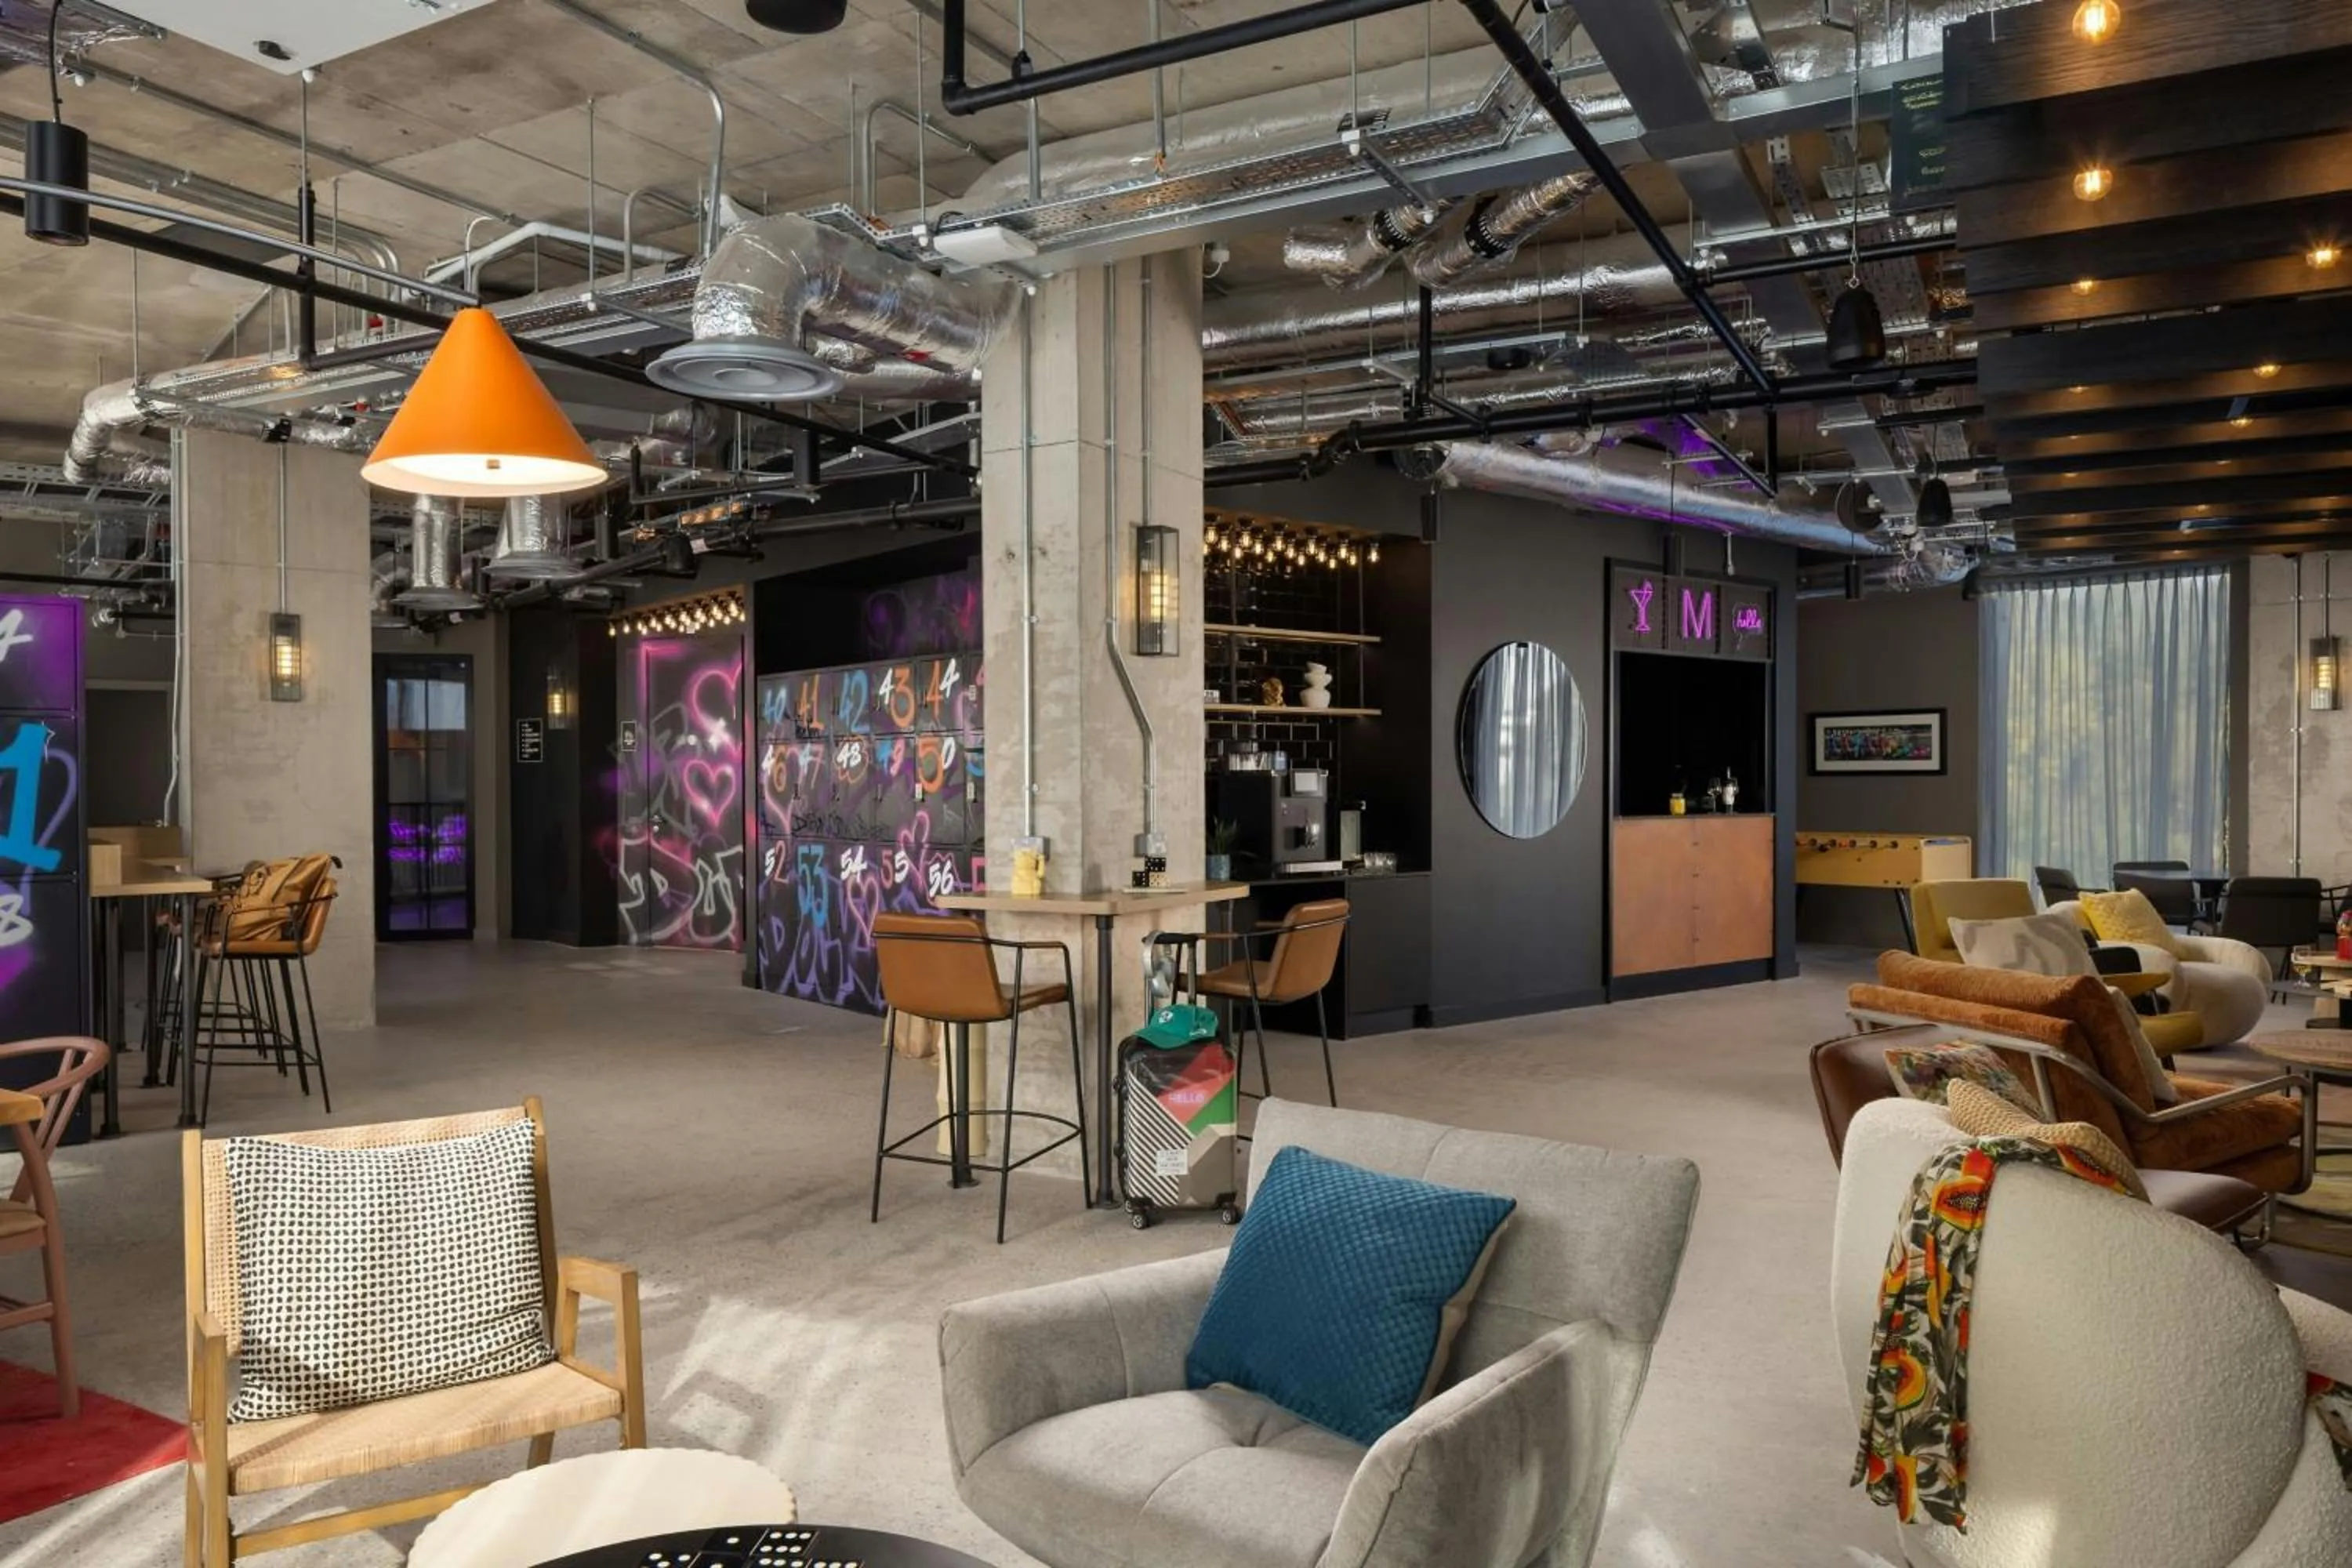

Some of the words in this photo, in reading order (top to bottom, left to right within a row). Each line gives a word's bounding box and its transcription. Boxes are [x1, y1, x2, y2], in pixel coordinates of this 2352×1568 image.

[1682, 589, 1712, 640] M
[764, 686, 787, 725] 40
[797, 673, 825, 731] 41
[839, 669, 870, 734] 42
[879, 667, 916, 728] 43
[925, 658, 960, 723] 44
[762, 744, 787, 793] 46
[837, 742, 862, 769] 48
[875, 735, 907, 778] 49
[916, 735, 956, 793] 50
[764, 840, 789, 884] 52
[797, 844, 829, 928] 53
[840, 844, 867, 884] 54
[880, 849, 909, 888] 55
[928, 859, 955, 898] 56
